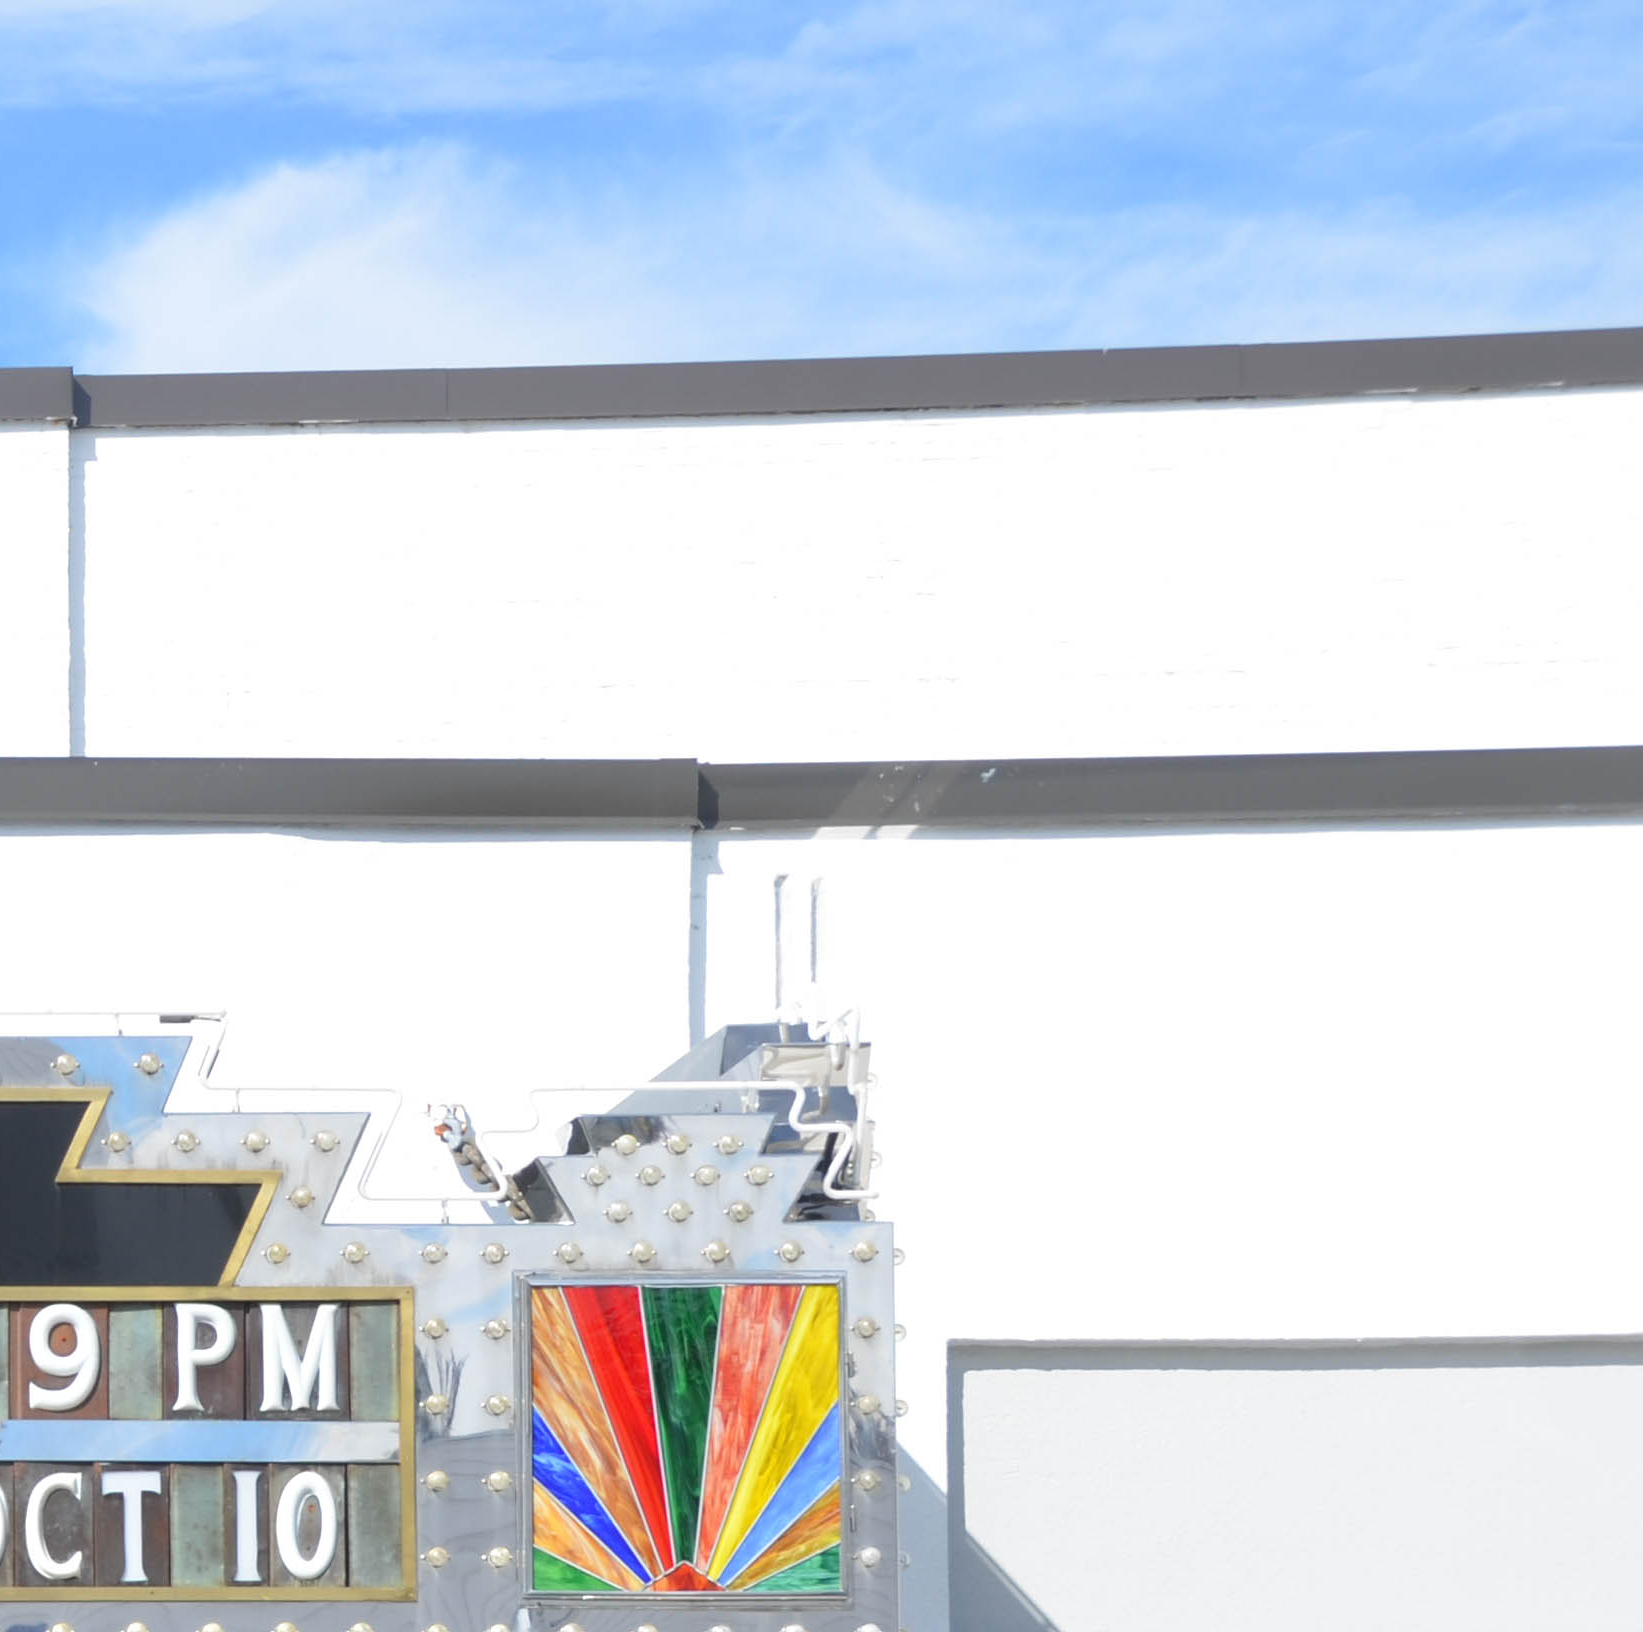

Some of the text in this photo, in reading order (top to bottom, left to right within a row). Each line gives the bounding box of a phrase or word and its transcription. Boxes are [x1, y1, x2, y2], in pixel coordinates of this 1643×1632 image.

[27, 1303, 100, 1412] 9
[173, 1303, 340, 1412] PM
[234, 1470, 338, 1582] 10
